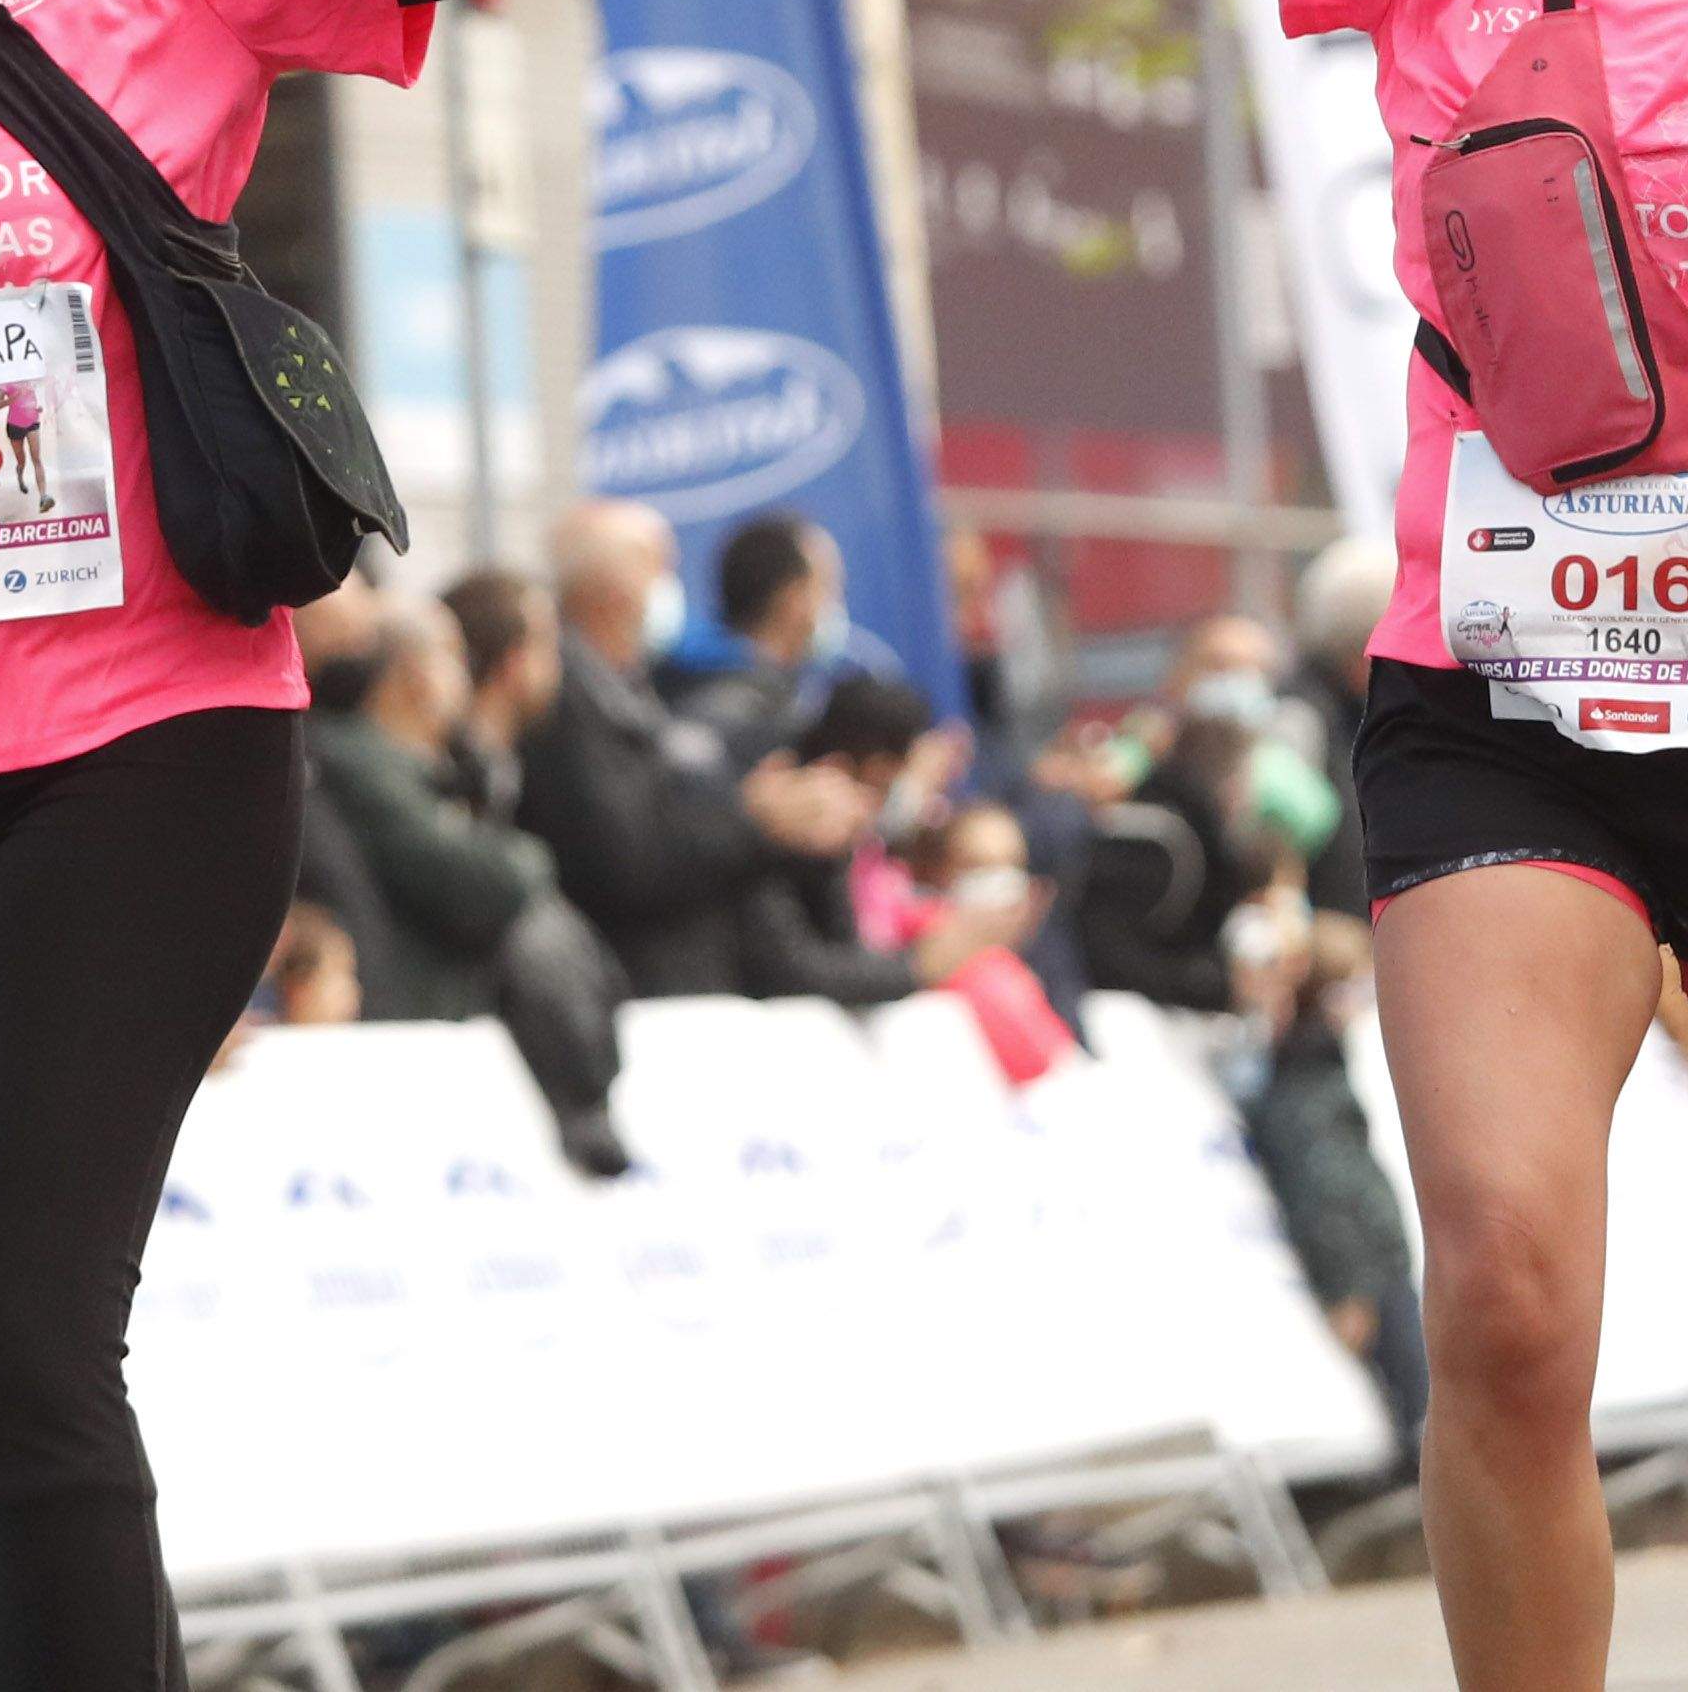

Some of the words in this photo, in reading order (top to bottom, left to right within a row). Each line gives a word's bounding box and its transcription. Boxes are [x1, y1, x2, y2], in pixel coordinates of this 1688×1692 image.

[36, 567, 99, 586] ZURICH
[1587, 627, 1661, 655] 1640
[1517, 660, 1544, 678] DE
[1547, 659, 1583, 677] LES
[1587, 660, 1651, 680] DONES
[1657, 663, 1683, 681] DE
[1604, 709, 1659, 723] Santander
